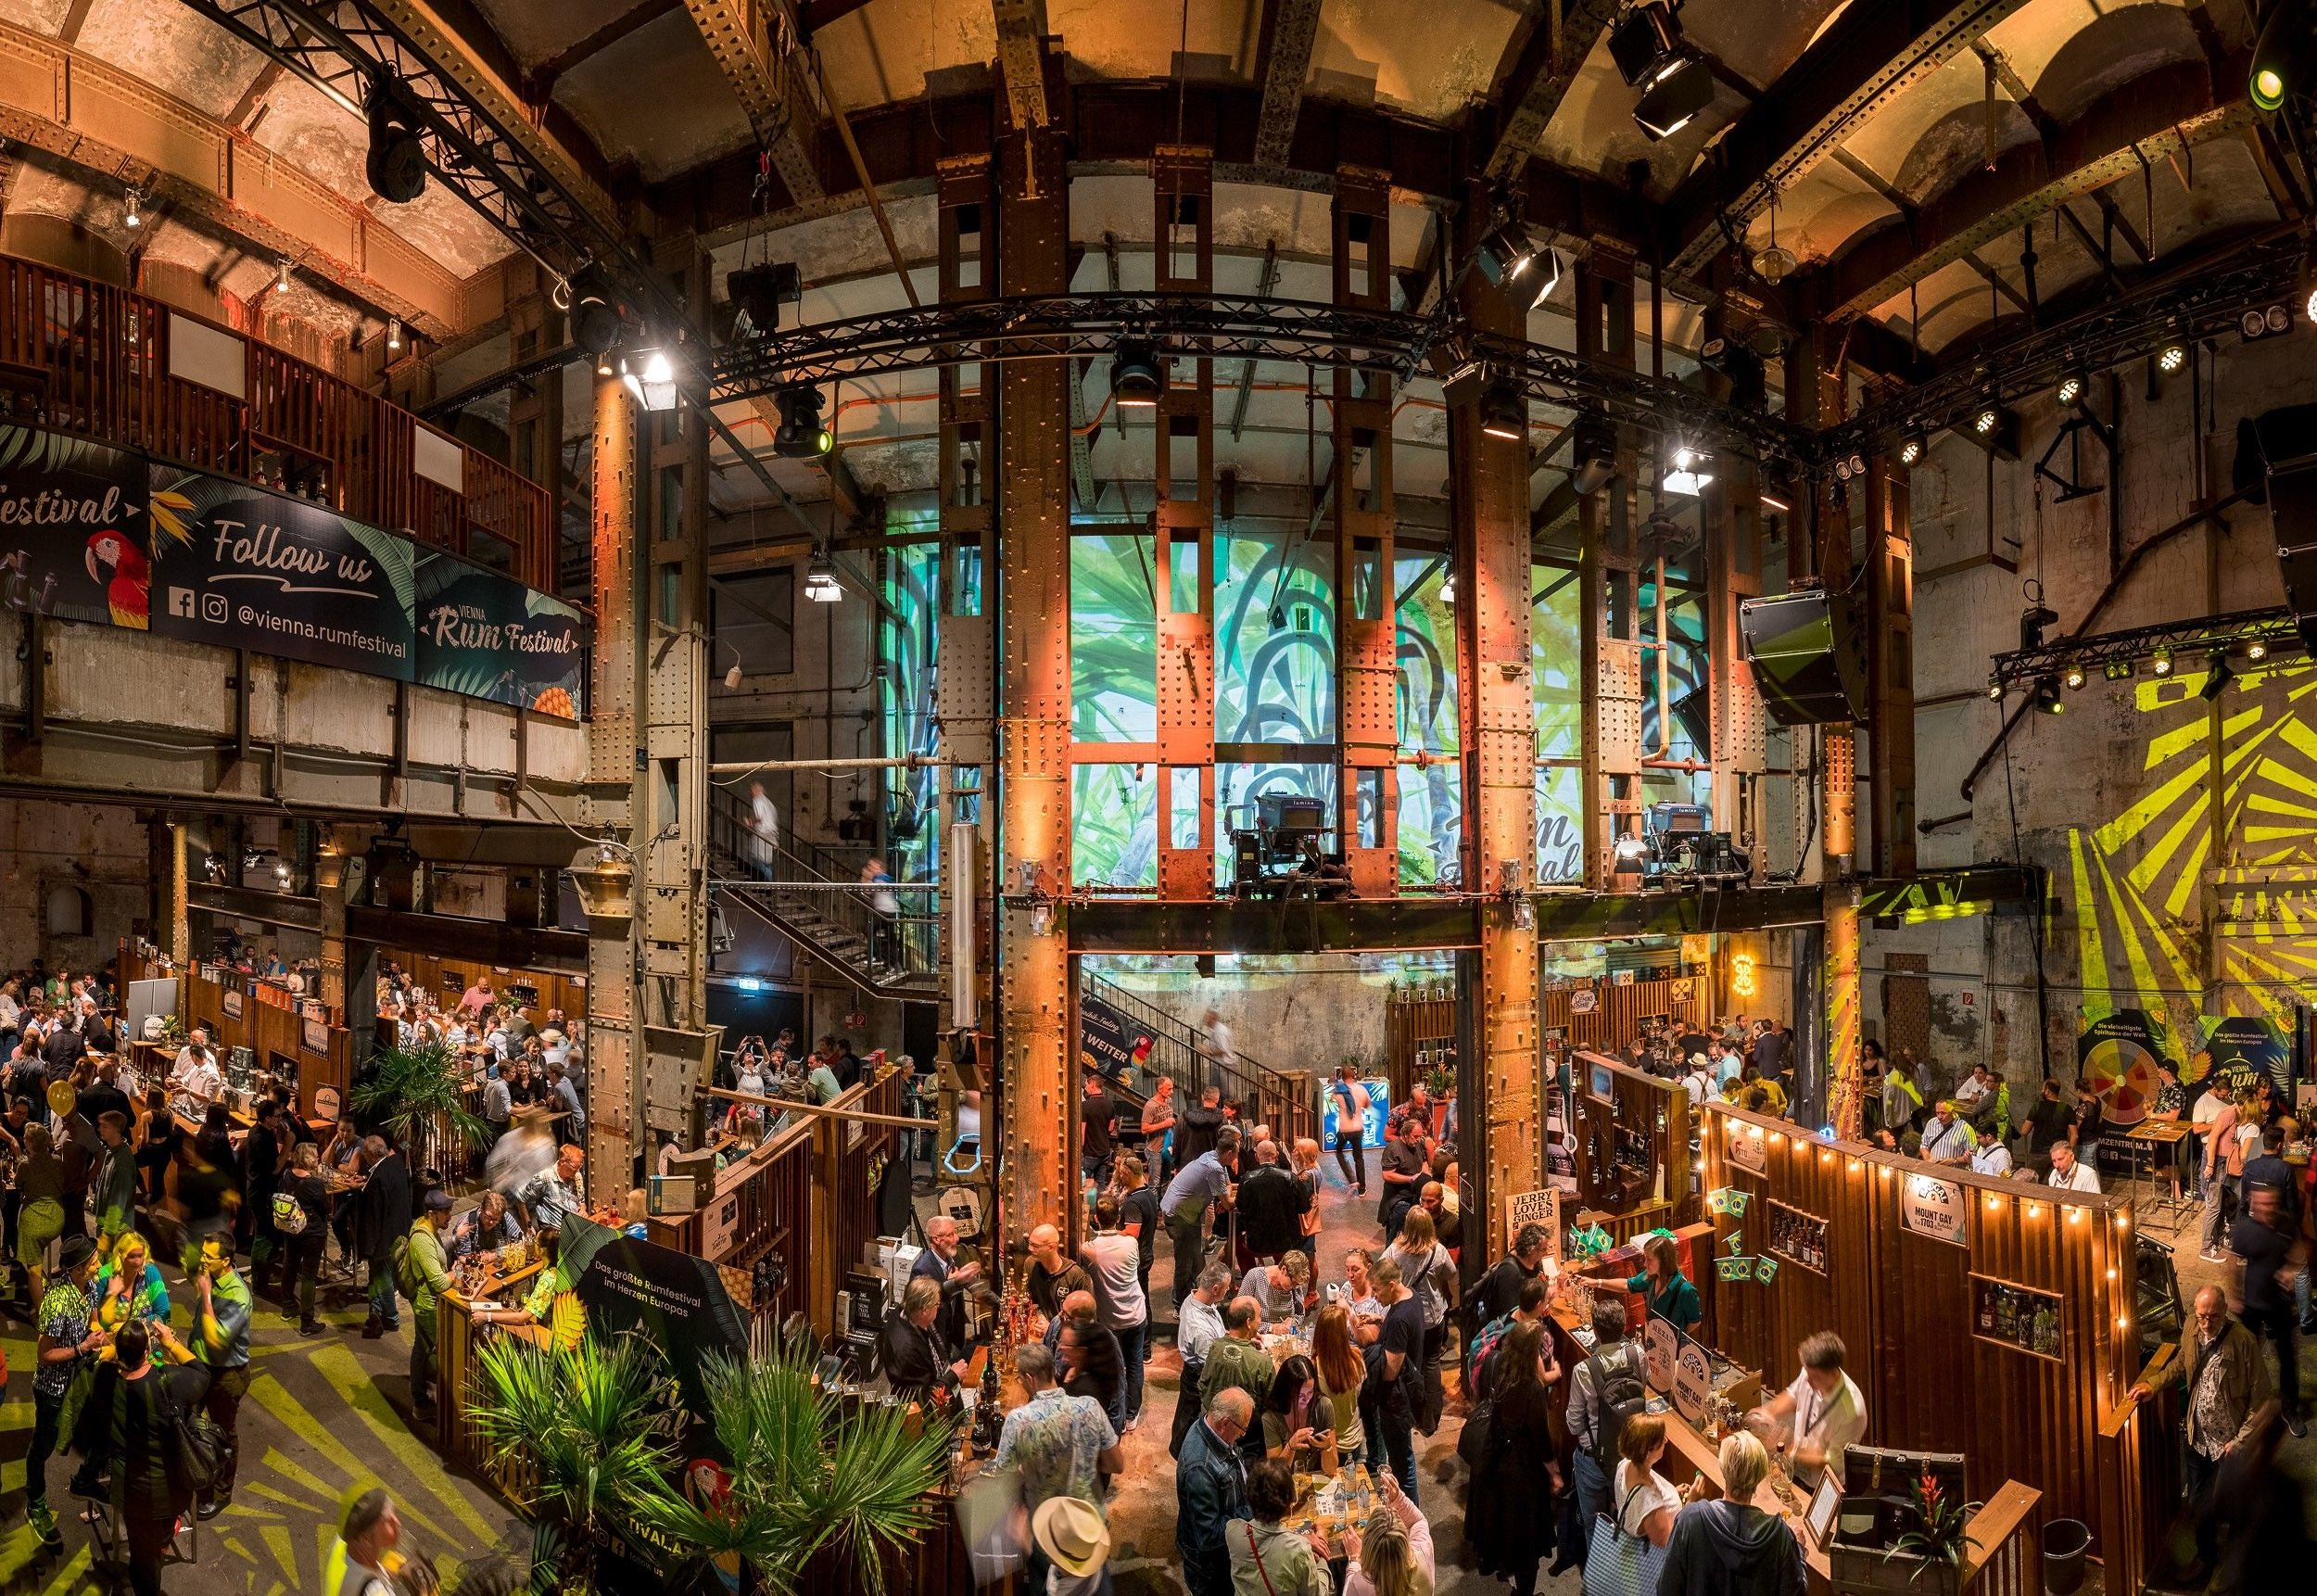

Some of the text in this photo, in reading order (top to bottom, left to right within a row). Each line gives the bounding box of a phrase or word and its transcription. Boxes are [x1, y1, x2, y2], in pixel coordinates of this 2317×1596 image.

[0, 485, 120, 526] estival
[213, 519, 373, 582] Follow us
[458, 604, 487, 621] VIENNA
[238, 605, 406, 659] @vienna.rumfestival
[504, 623, 571, 654] Festival
[2095, 1029, 2121, 1037] Spirituose
[1087, 1033, 1128, 1063] WEITER
[2232, 1065, 2250, 1073] VIENNA
[1513, 1191, 1552, 1206] JERRY
[1513, 1199, 1553, 1216] LOVES
[1513, 1209, 1553, 1222] GINGER
[1915, 1207, 1953, 1224] MOUNT GAY
[1920, 1218, 1934, 1228] 1703
[595, 1260, 701, 1308] Das größte Rumfestival
[603, 1276, 689, 1318] im Herzen Europas
[1682, 1353, 1703, 1381] BRUGAL
[1677, 1378, 1694, 1397] MOUNT
[1691, 1389, 1703, 1406] GAY
